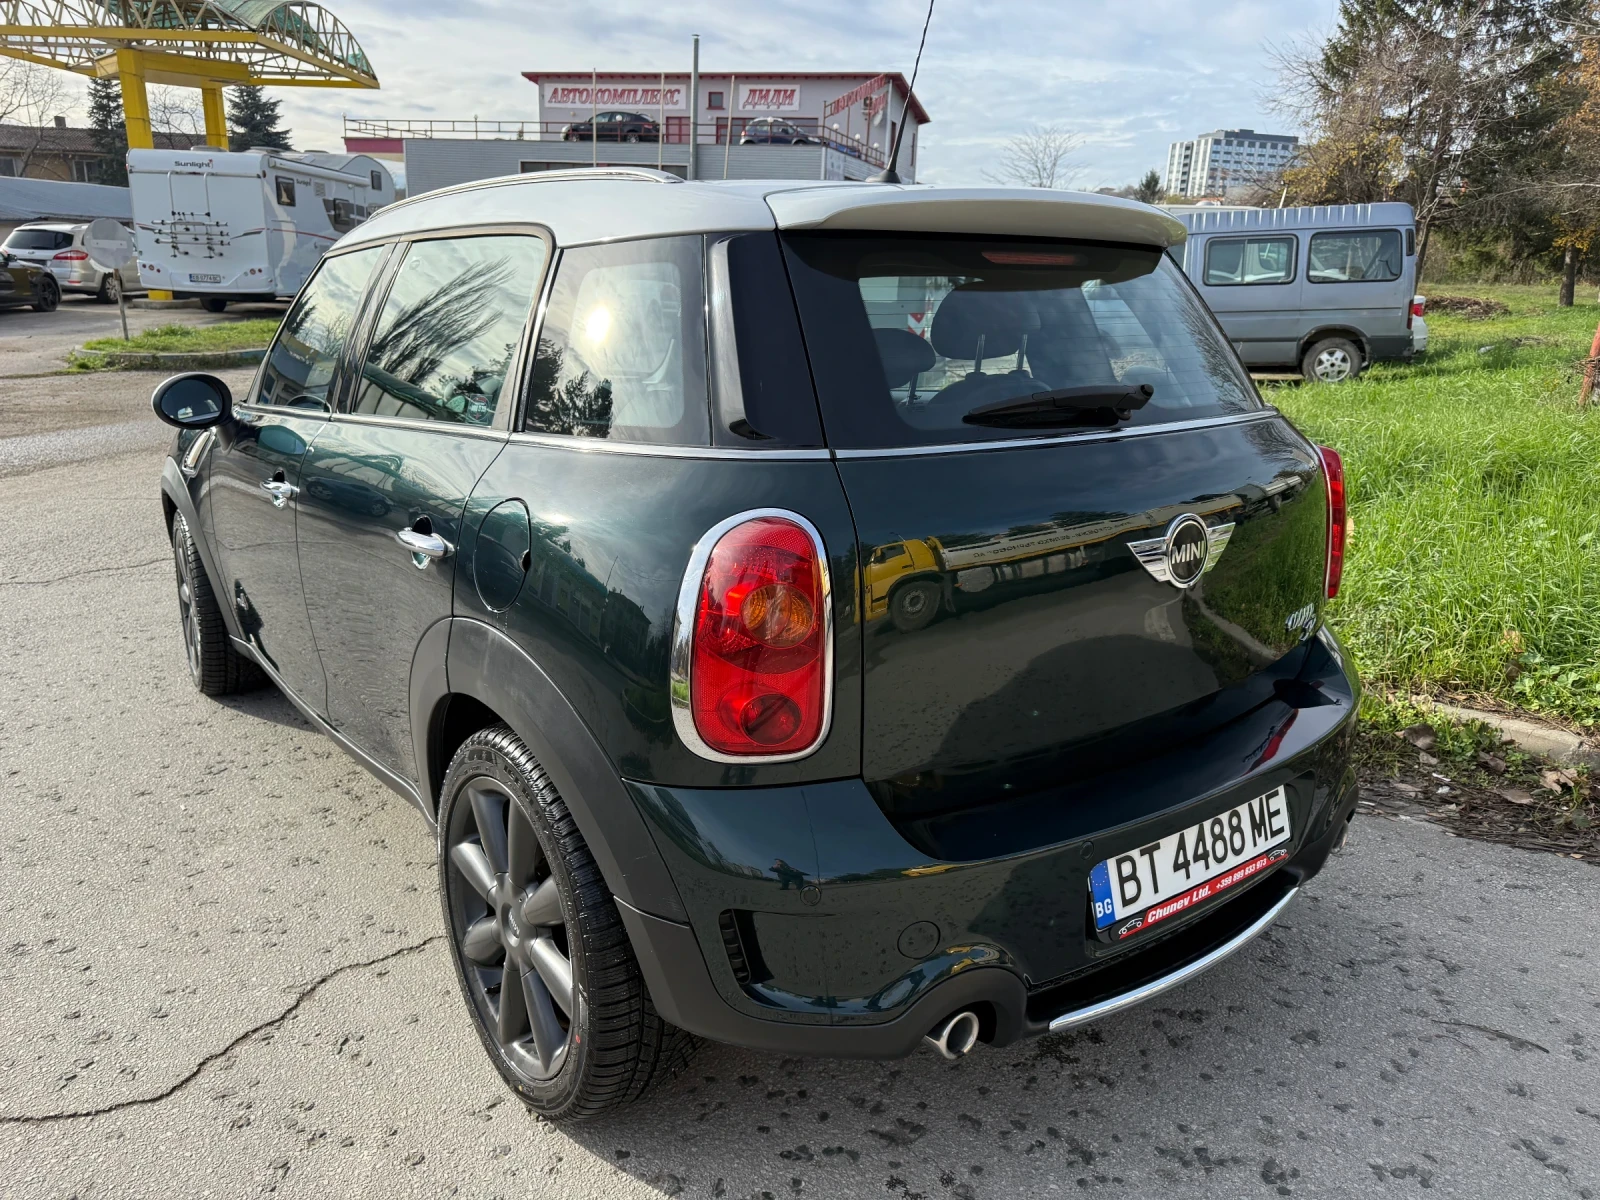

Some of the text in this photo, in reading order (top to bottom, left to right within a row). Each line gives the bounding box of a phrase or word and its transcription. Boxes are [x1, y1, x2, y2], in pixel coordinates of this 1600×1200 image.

[548, 87, 797, 109] АВТОКОМПЛЕКС ДИДИ
[174, 160, 211, 169] Sunlight
[1171, 540, 1206, 565] MINI
[1115, 789, 1285, 909] BT 4488 ME
[1095, 898, 1113, 918] BG
[1147, 895, 1191, 923] Chunev
[1192, 885, 1211, 902] Ltd.
